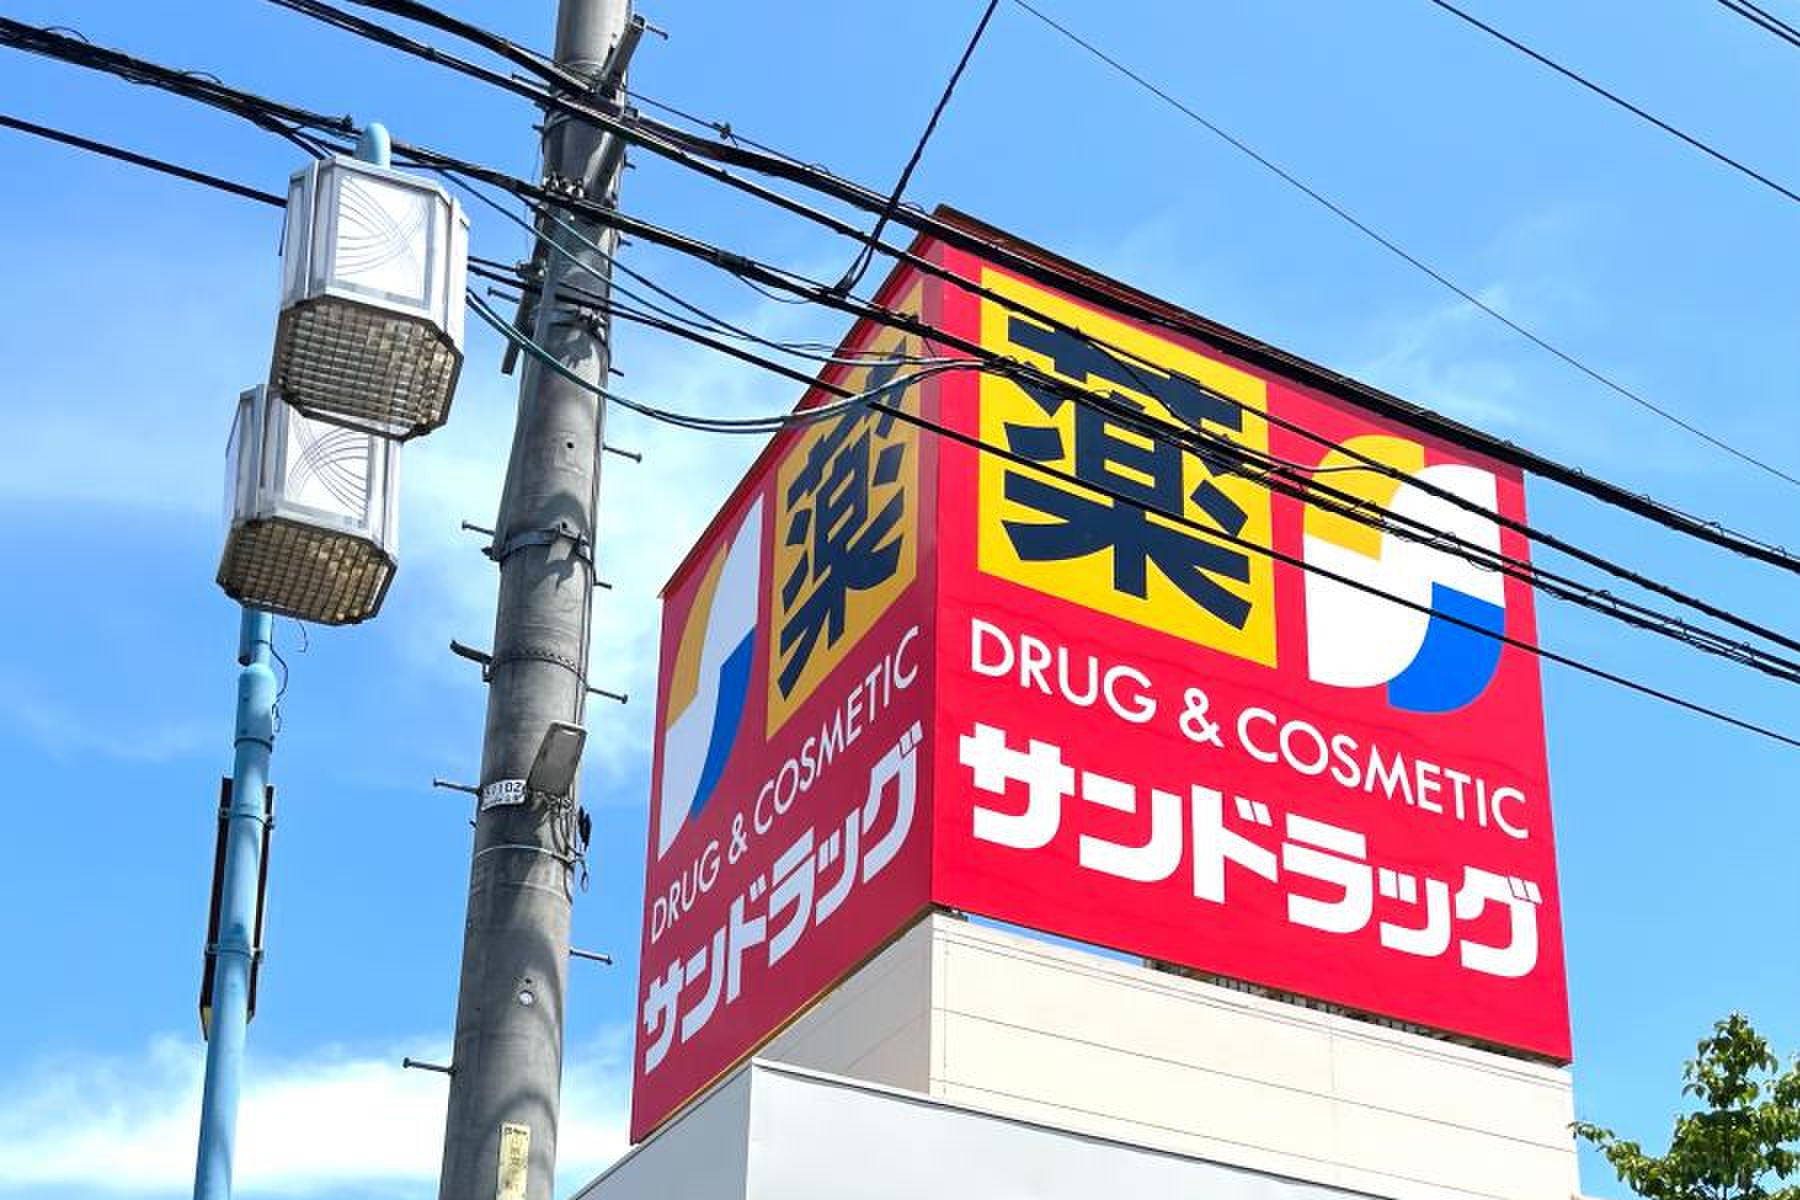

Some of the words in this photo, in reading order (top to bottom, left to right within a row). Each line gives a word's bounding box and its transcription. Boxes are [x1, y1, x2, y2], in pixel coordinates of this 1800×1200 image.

[778, 325, 911, 704] 薬
[1000, 313, 1256, 633] 薬
[650, 850, 722, 945] DRUG
[727, 810, 749, 859] &
[752, 624, 921, 837] COSMETIC
[958, 722, 1543, 980] サンドラッグ
[970, 618, 1154, 726] DRUG
[1179, 686, 1224, 748] &
[1237, 704, 1531, 841] COSMETIC
[642, 720, 924, 1076] サンドラッグ
